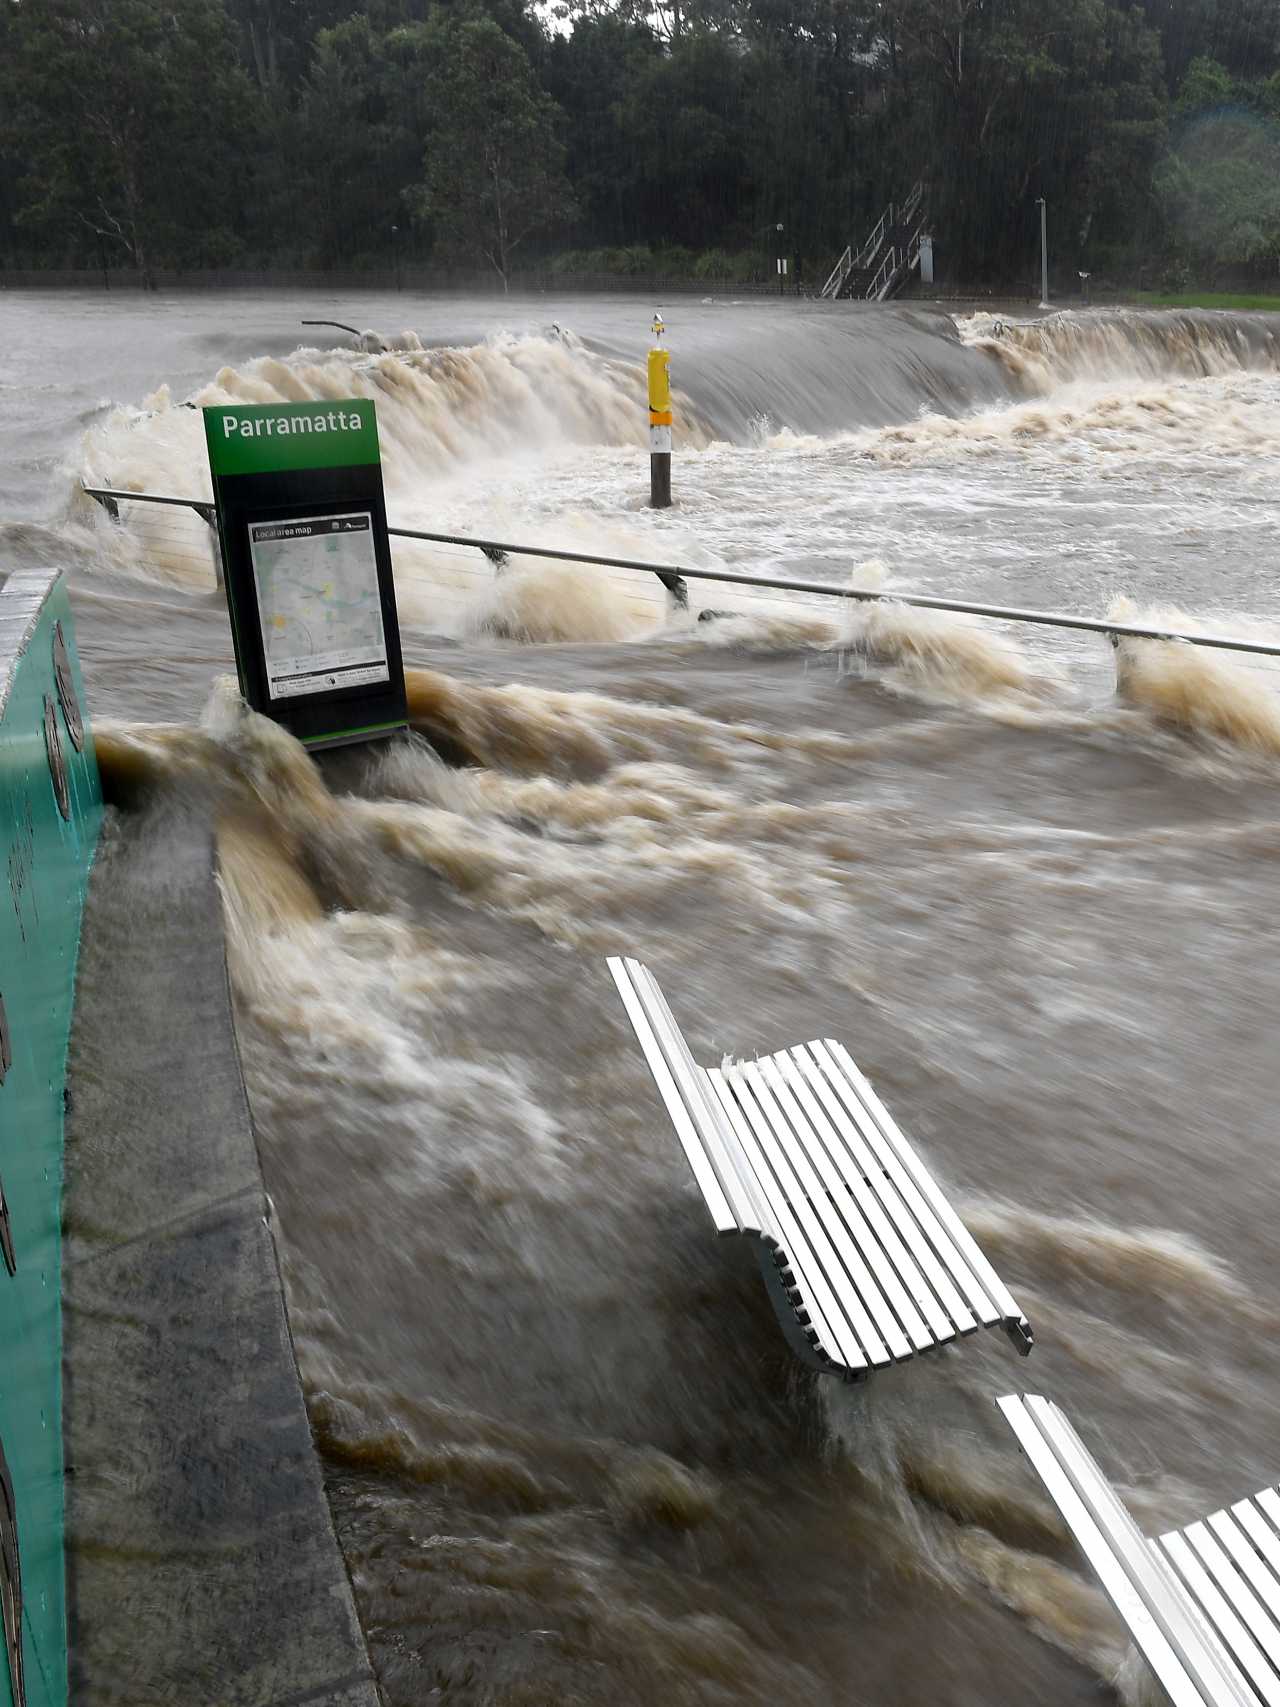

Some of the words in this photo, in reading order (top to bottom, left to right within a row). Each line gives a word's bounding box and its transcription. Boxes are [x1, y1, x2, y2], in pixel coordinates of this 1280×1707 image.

[222, 411, 362, 438] Parramatta
[255, 527, 276, 538] Local
[295, 527, 312, 536] map
